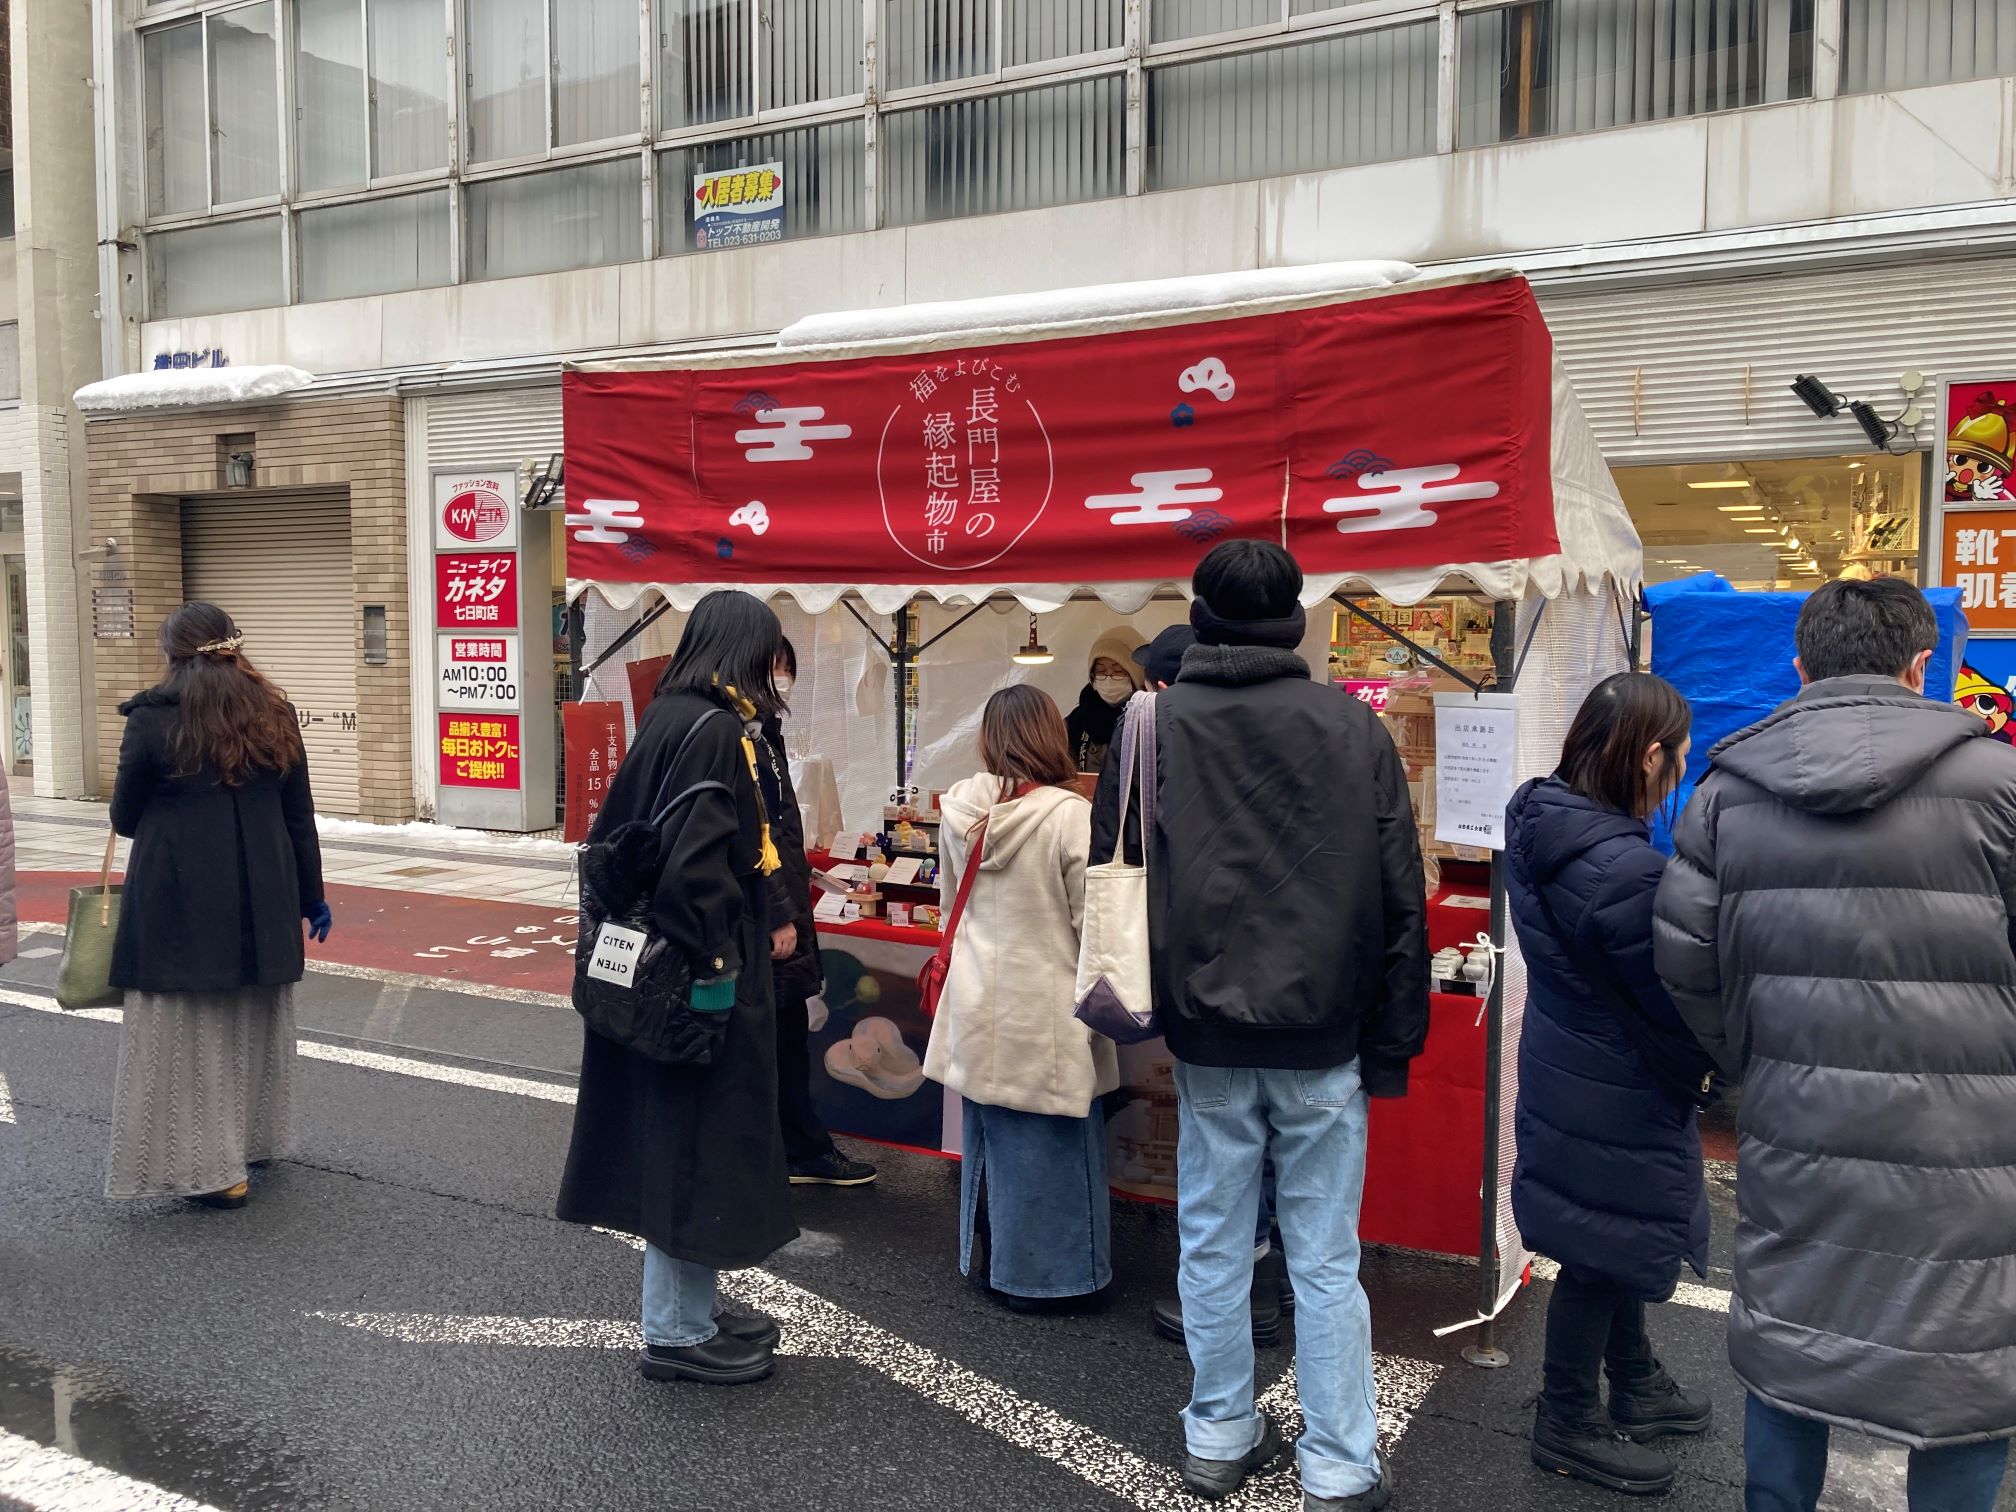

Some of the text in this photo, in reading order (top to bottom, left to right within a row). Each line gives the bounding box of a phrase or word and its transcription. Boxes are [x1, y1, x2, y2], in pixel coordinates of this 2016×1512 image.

[701, 169, 774, 210] 入居者募集
[708, 218, 780, 238] トップ不動産開発
[909, 357, 1020, 403] 福をよびこむ
[965, 386, 1001, 538] 長門屋の
[452, 479, 499, 492] ファッション衣料
[923, 412, 960, 554] 縁起物市
[451, 500, 503, 532] KANETA
[447, 559, 512, 574] ニューライフ
[445, 576, 506, 602] カネタ
[454, 605, 499, 620] 七日町店
[454, 642, 503, 658] 営業時間
[449, 721, 507, 738] 品揃え豊富!
[442, 737, 518, 758] 毎日おトクに
[603, 936, 635, 951] CITEN
[596, 958, 628, 974] CITEN
